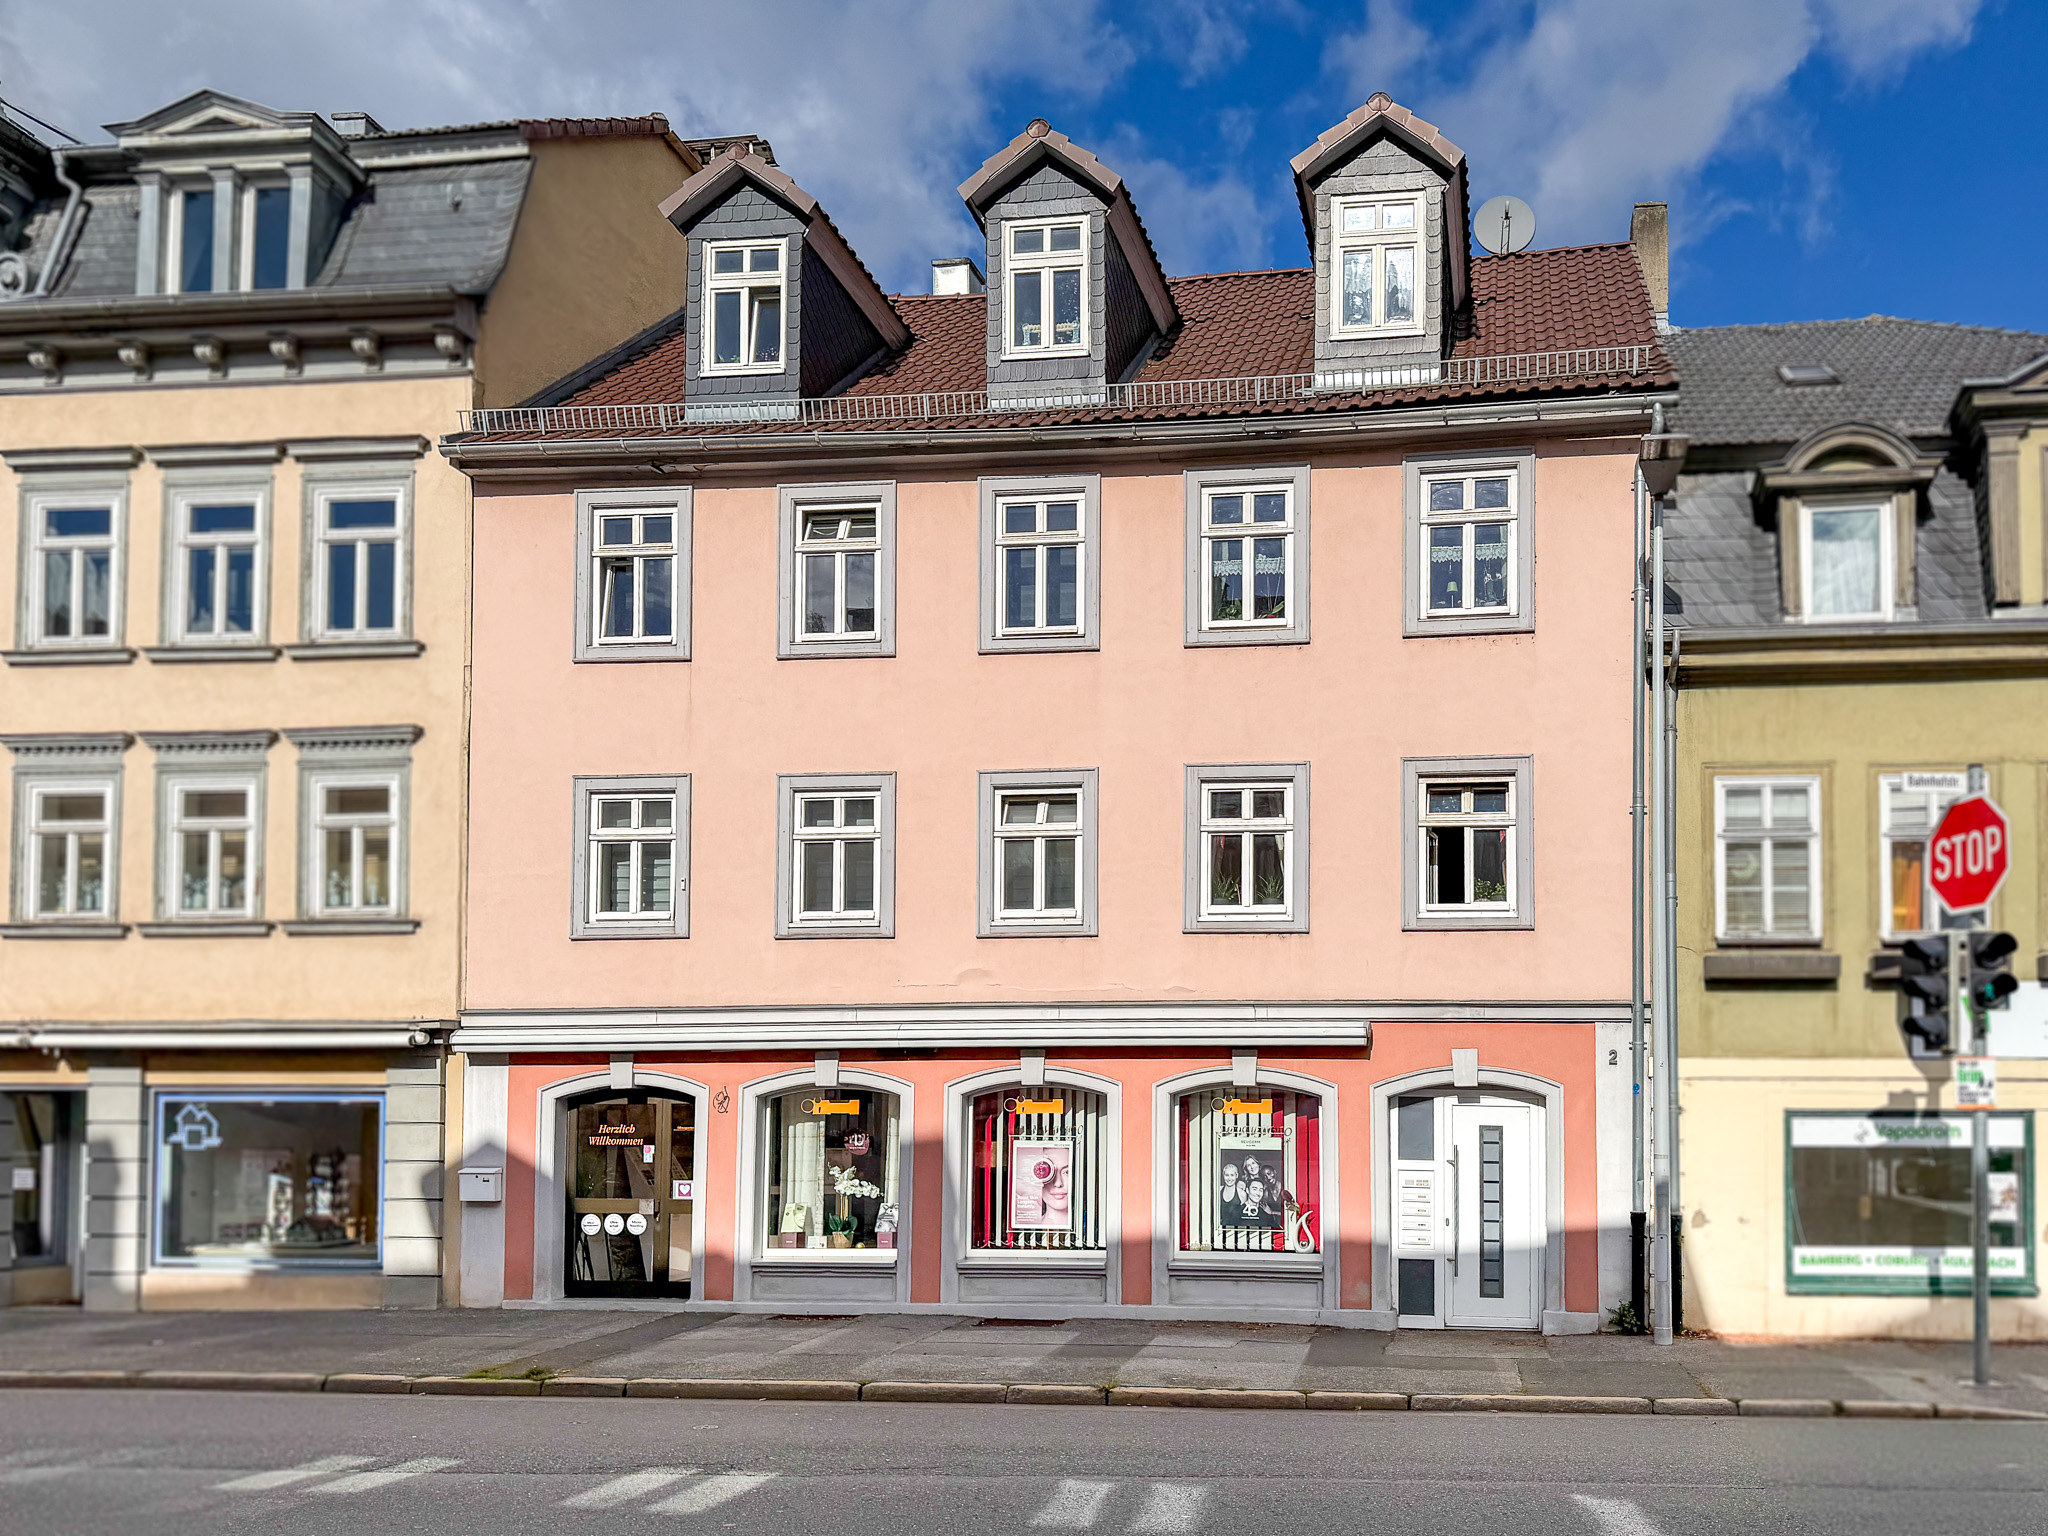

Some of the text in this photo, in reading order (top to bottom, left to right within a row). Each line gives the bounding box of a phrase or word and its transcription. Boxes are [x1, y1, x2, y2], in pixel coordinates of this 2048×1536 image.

[1934, 824, 2002, 882] STOP
[1608, 1049, 1618, 1066] 2
[598, 1123, 636, 1134] Herzlich
[588, 1135, 644, 1146] Willkommen
[1242, 1204, 1259, 1216] 40
